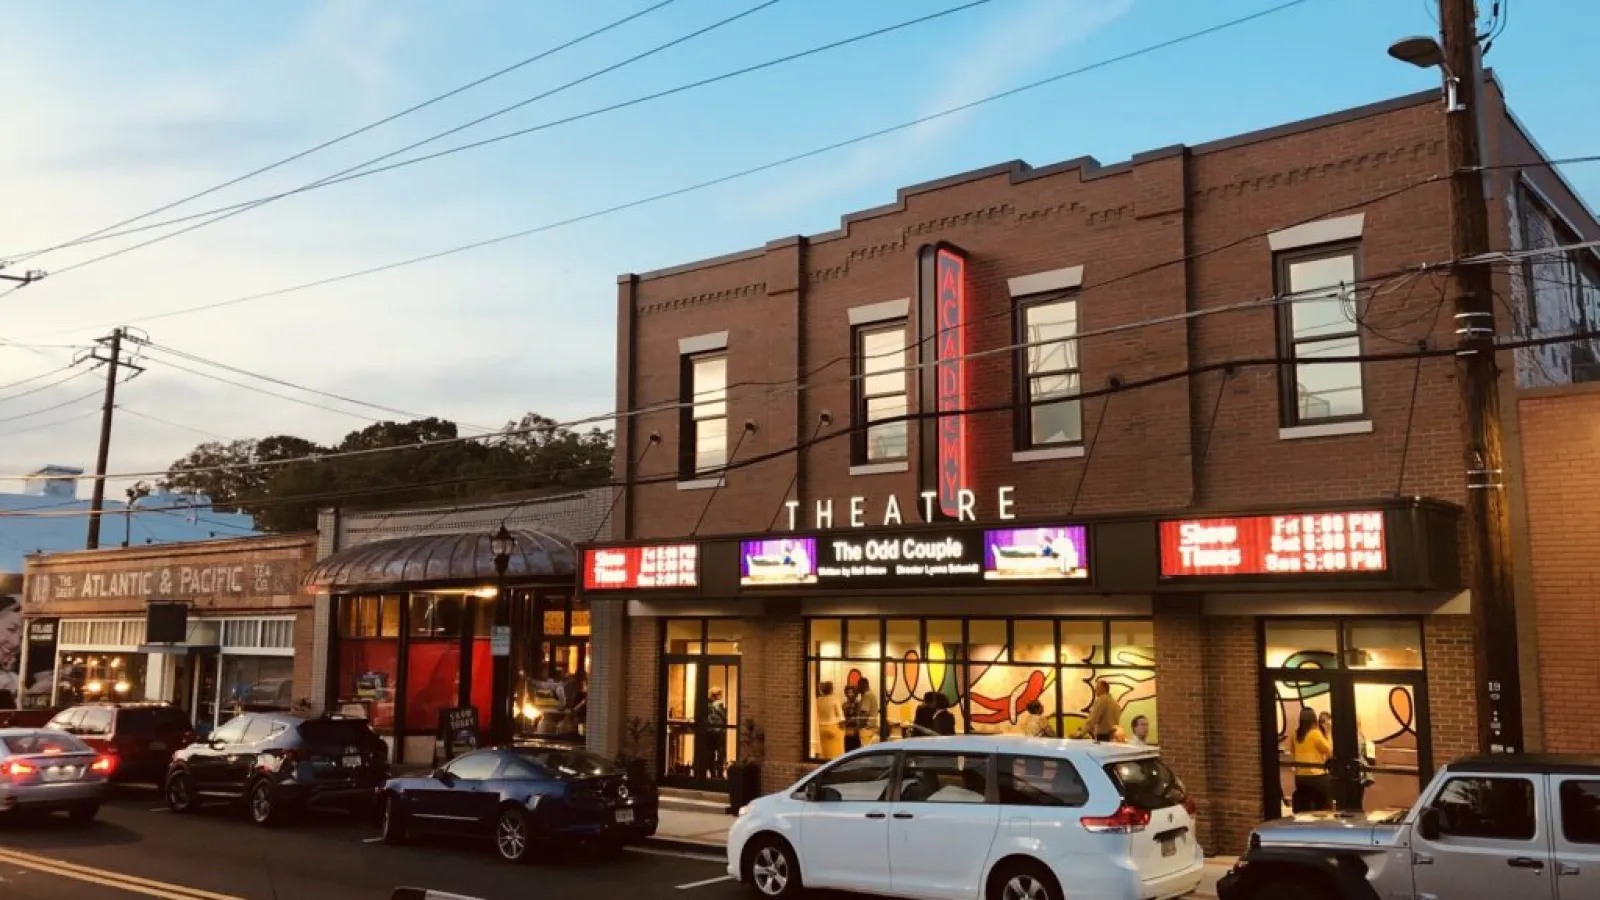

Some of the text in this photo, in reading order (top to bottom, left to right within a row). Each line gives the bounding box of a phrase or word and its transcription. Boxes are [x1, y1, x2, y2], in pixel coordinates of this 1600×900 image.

[941, 266, 960, 502] ACADEMY
[785, 486, 1016, 531] THEATRE
[1180, 523, 1238, 545] Show
[1273, 517, 1300, 534] Fri
[1348, 513, 1382, 532] PM
[833, 537, 963, 561] The Odd Couple
[1348, 532, 1381, 550] PM
[680, 545, 696, 559] PM
[1179, 546, 1241, 567] Times
[1265, 550, 1382, 571] Sun 3:00 PM
[680, 559, 695, 571] PM
[81, 571, 153, 597] ATLANTIC
[159, 567, 173, 594] &
[180, 565, 243, 594] PACIFIC
[680, 572, 697, 585] PM
